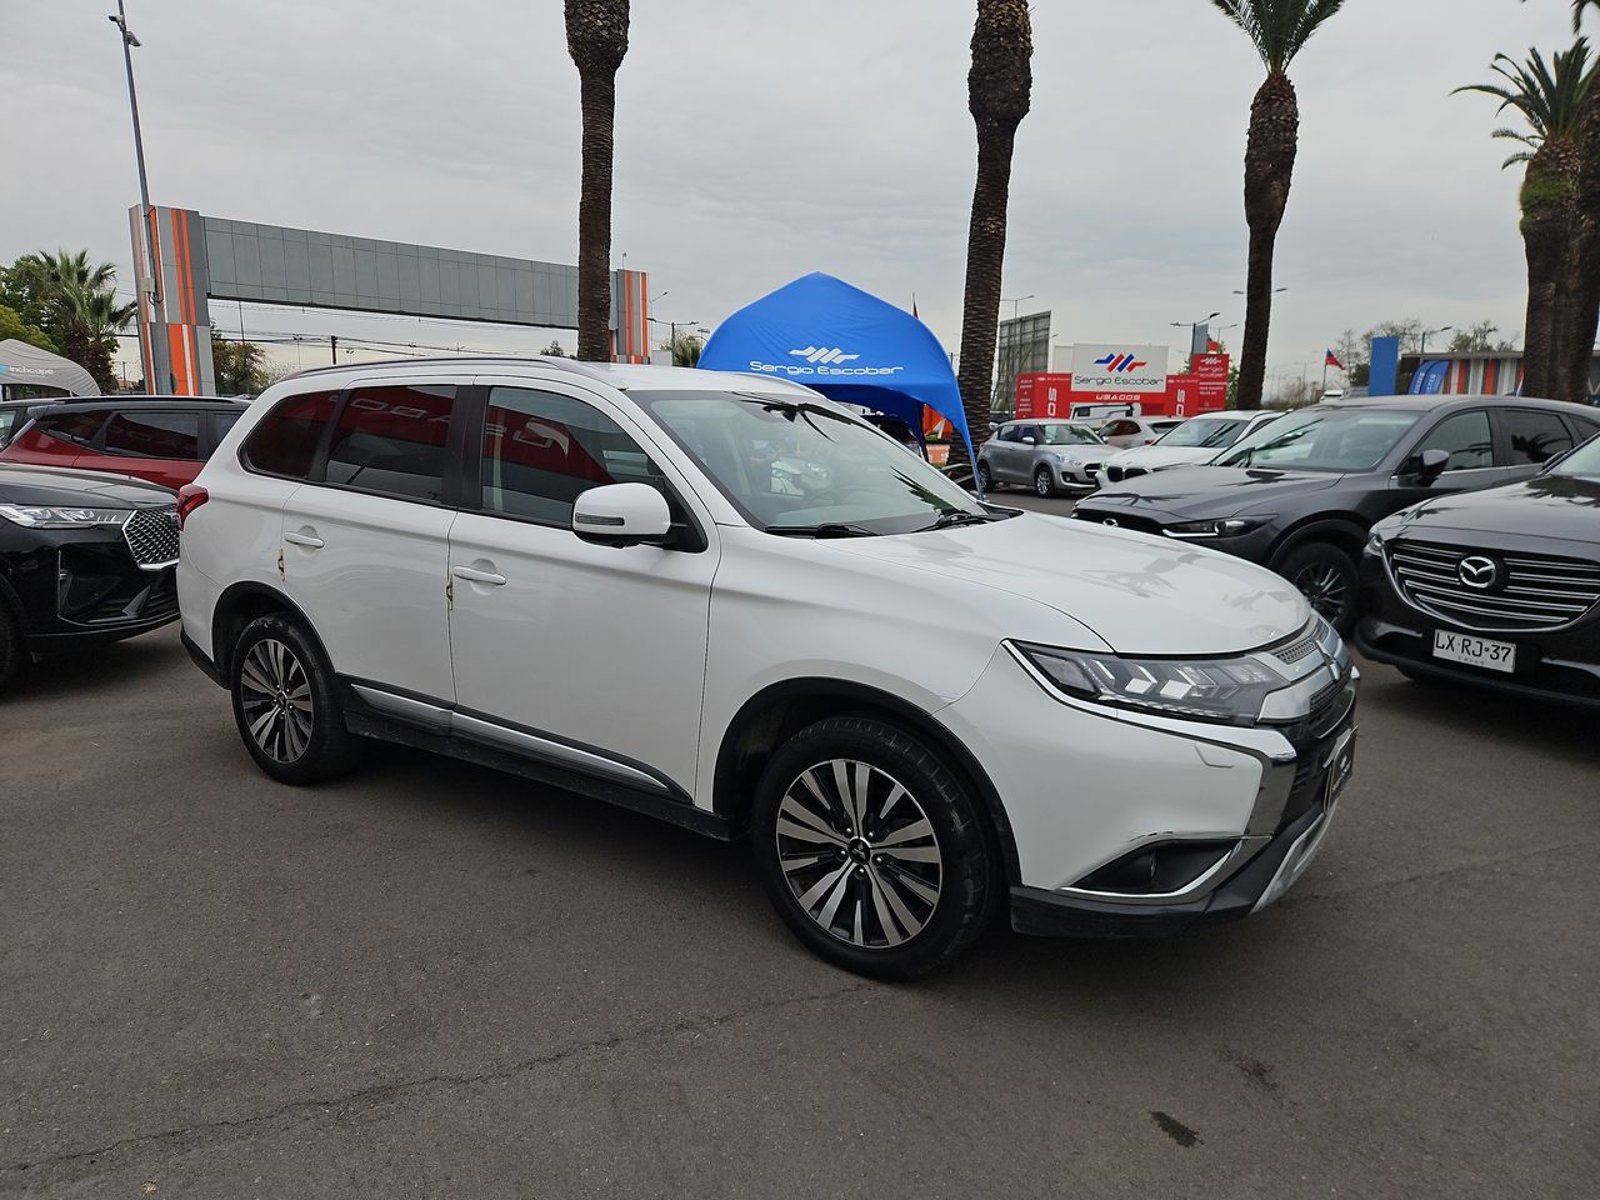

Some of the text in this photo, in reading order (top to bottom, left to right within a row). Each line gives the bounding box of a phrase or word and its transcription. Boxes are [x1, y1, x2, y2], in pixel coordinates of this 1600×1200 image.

[750, 360, 904, 376] Sergo Escobar
[1074, 375, 1164, 386] Sergo Escobar
[1095, 393, 1141, 401] USADOS
